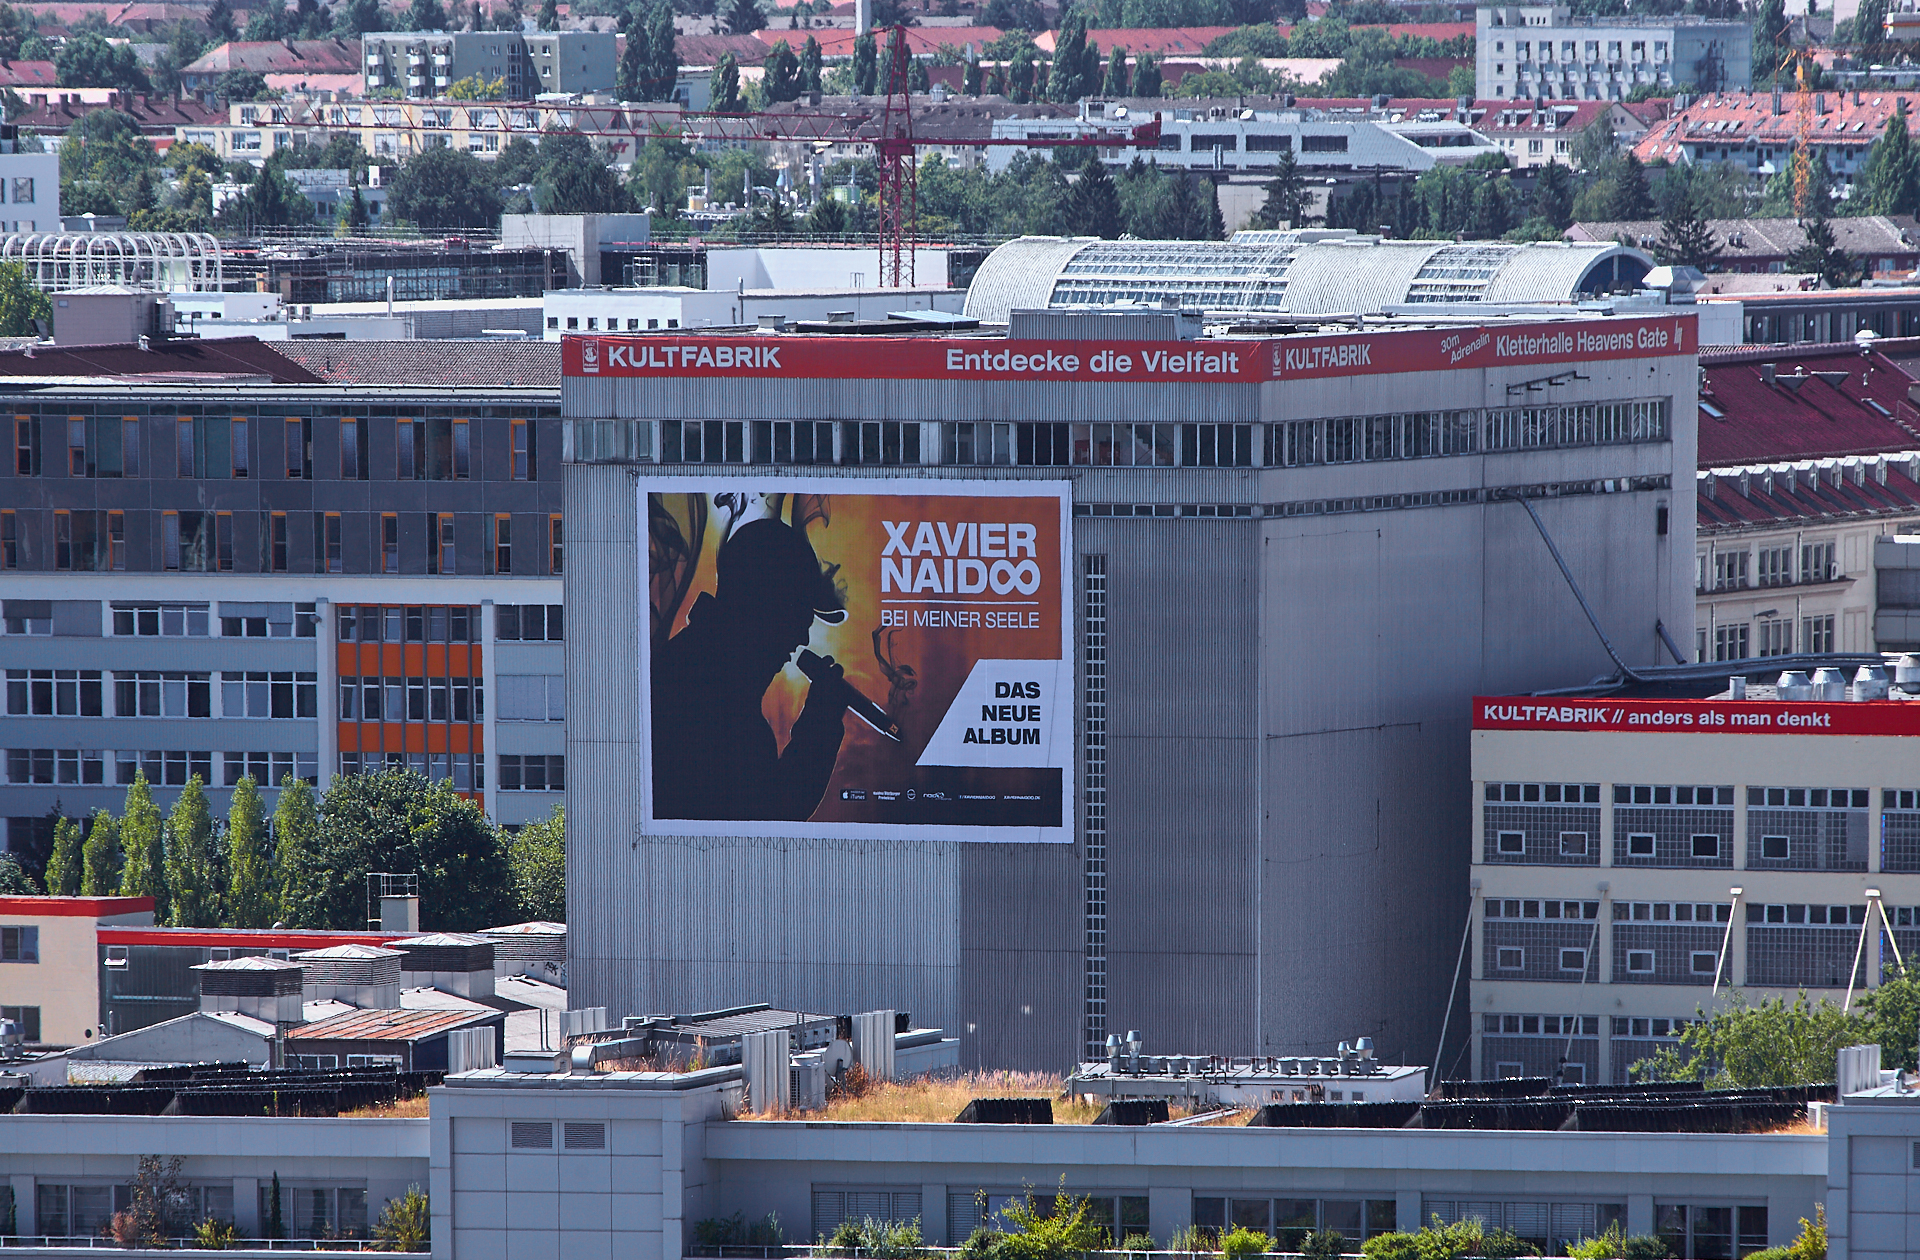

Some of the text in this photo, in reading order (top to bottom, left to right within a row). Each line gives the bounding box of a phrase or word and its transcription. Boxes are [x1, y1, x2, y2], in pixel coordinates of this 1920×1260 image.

[1440, 333, 1460, 354] 30m
[1450, 332, 1490, 364] Adrenalin
[1496, 331, 1573, 357] Kletterhalle
[1577, 329, 1633, 352] Heavens
[1637, 326, 1668, 349] Gate
[608, 345, 782, 369] KULTFABRIK
[946, 348, 1239, 374] Entdecke die Vielfalt
[1285, 343, 1372, 371] KULTFABRIK
[881, 520, 1037, 558] XAVIER
[881, 609, 1040, 629] BEI MEINER SEELE
[995, 681, 1041, 699] DAS
[981, 705, 1041, 722] NEUE
[1484, 705, 1608, 723] KULTFABRIK
[1698, 709, 1726, 725] als
[1730, 713, 1771, 726] man
[1776, 711, 1831, 727] denkt
[963, 727, 1041, 745] ALBUM
